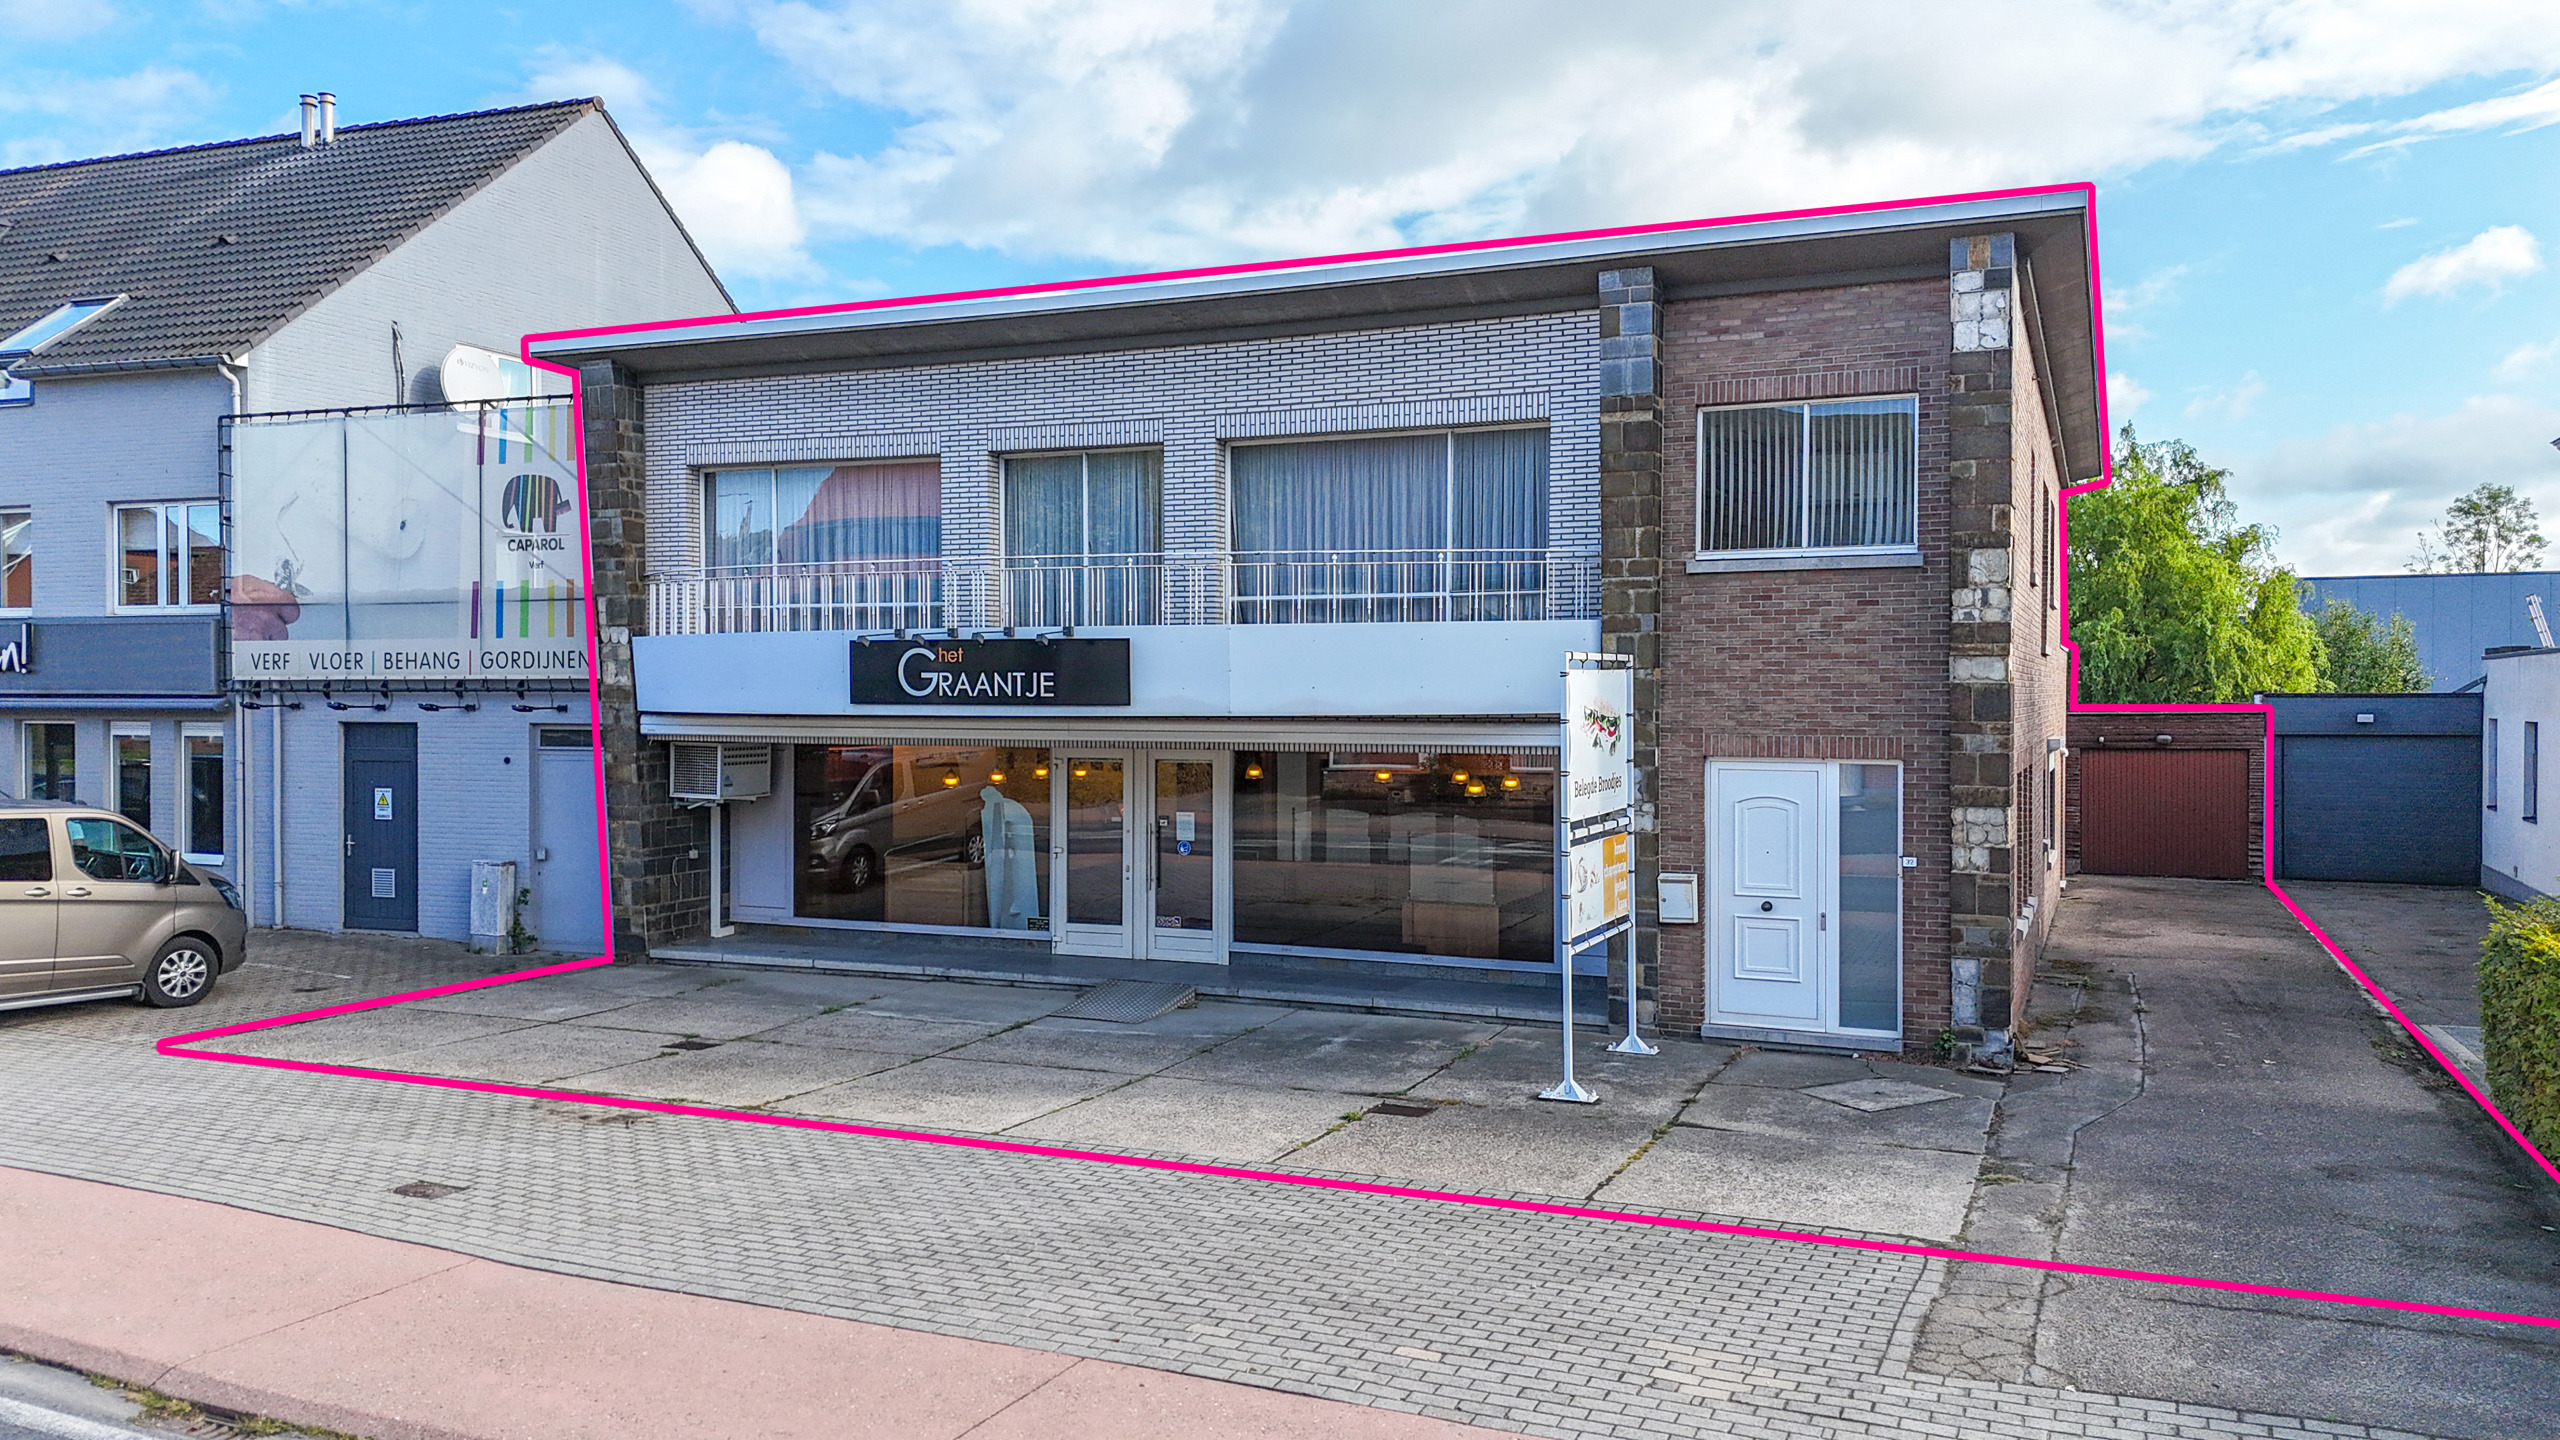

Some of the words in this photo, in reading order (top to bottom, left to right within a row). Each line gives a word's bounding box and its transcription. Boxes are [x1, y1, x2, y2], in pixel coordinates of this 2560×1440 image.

[507, 538, 565, 552] CAPAROL
[250, 652, 291, 671] VERF
[308, 652, 364, 670] VLOER
[383, 651, 461, 670] BEHANG
[480, 650, 590, 669] GORDIJNEN
[937, 647, 964, 663] het
[897, 646, 1055, 698] GRAANTJE
[1574, 777, 1598, 800] Belegde
[1598, 772, 1622, 793] Broodjes
